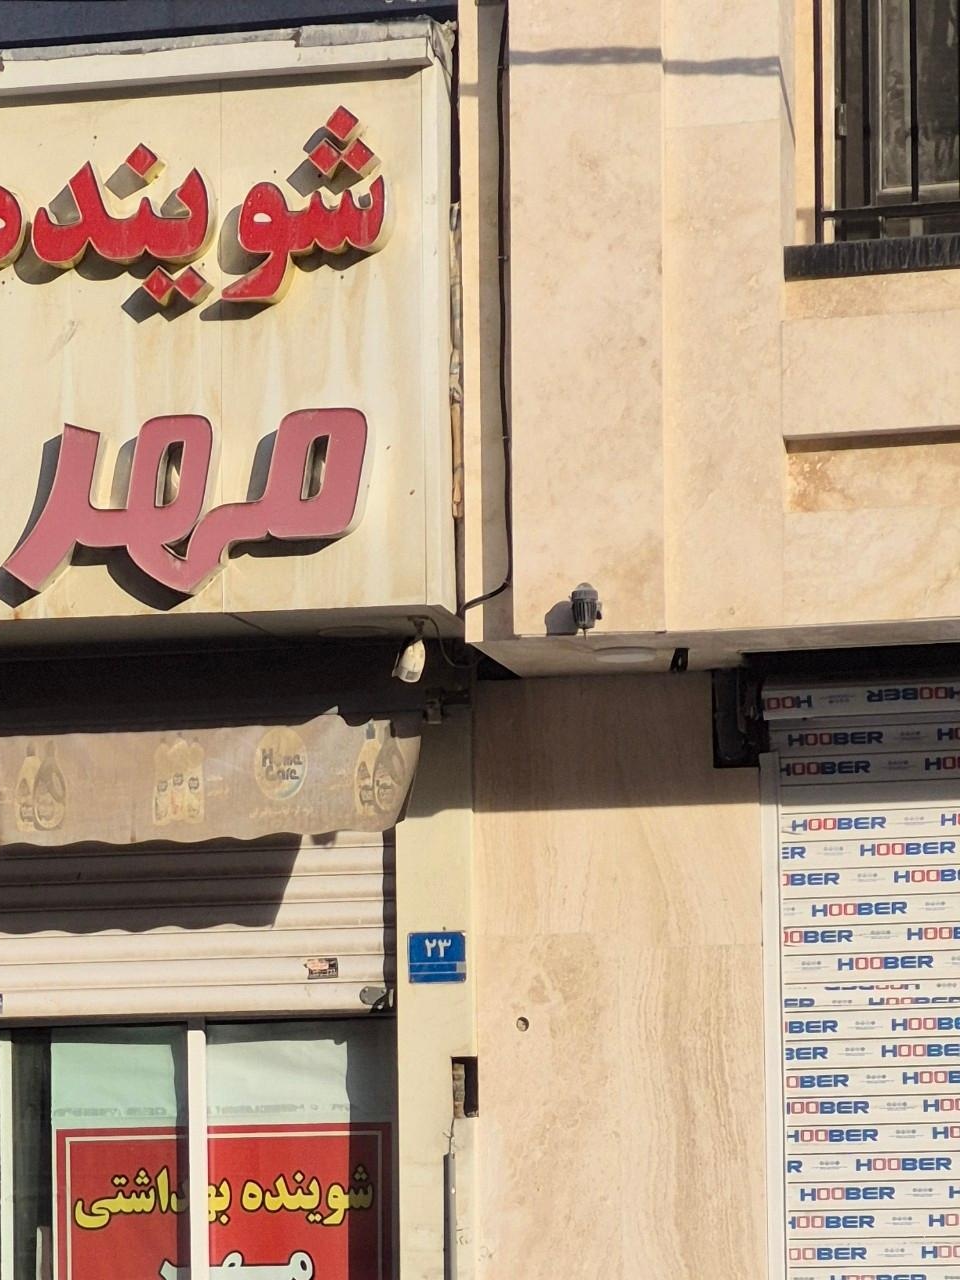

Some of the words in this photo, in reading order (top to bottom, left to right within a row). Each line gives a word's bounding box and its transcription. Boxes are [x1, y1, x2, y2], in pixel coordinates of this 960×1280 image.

[2, 408, 370, 595] مهر
[787, 731, 884, 746] HOOBER
[792, 816, 887, 832] HOOBER
[860, 841, 956, 857] HOOBER
[812, 901, 908, 918] HOOBER
[424, 938, 451, 957] ۲۳
[837, 955, 935, 972] HOOBER
[855, 1157, 952, 1172] HOOBER
[241, 1164, 374, 1226] شوینده
[800, 1187, 896, 1202] HOOBER
